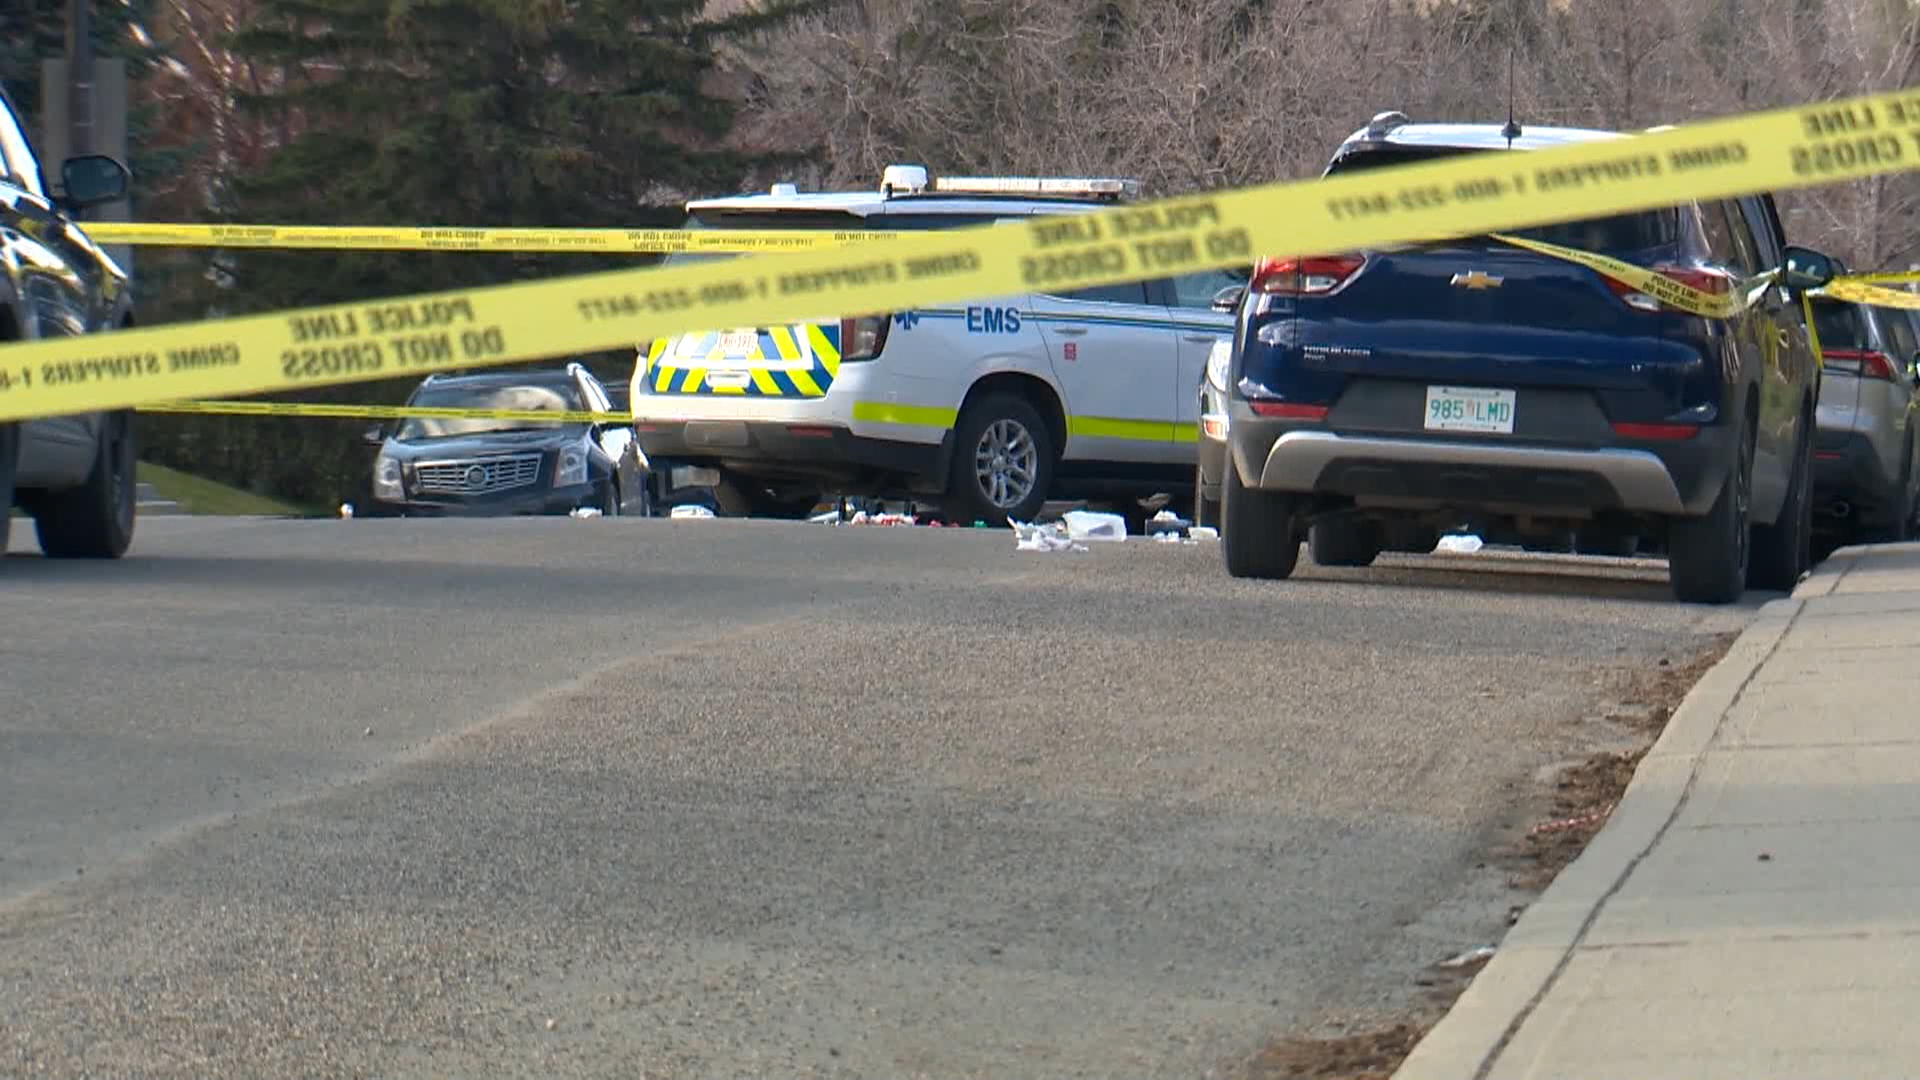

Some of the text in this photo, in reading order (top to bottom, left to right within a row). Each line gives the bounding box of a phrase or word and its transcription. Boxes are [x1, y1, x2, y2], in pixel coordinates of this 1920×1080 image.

[1651, 275, 1680, 293] POLICE
[967, 307, 1021, 334] EMS
[1430, 398, 1510, 423] 985 LMD
